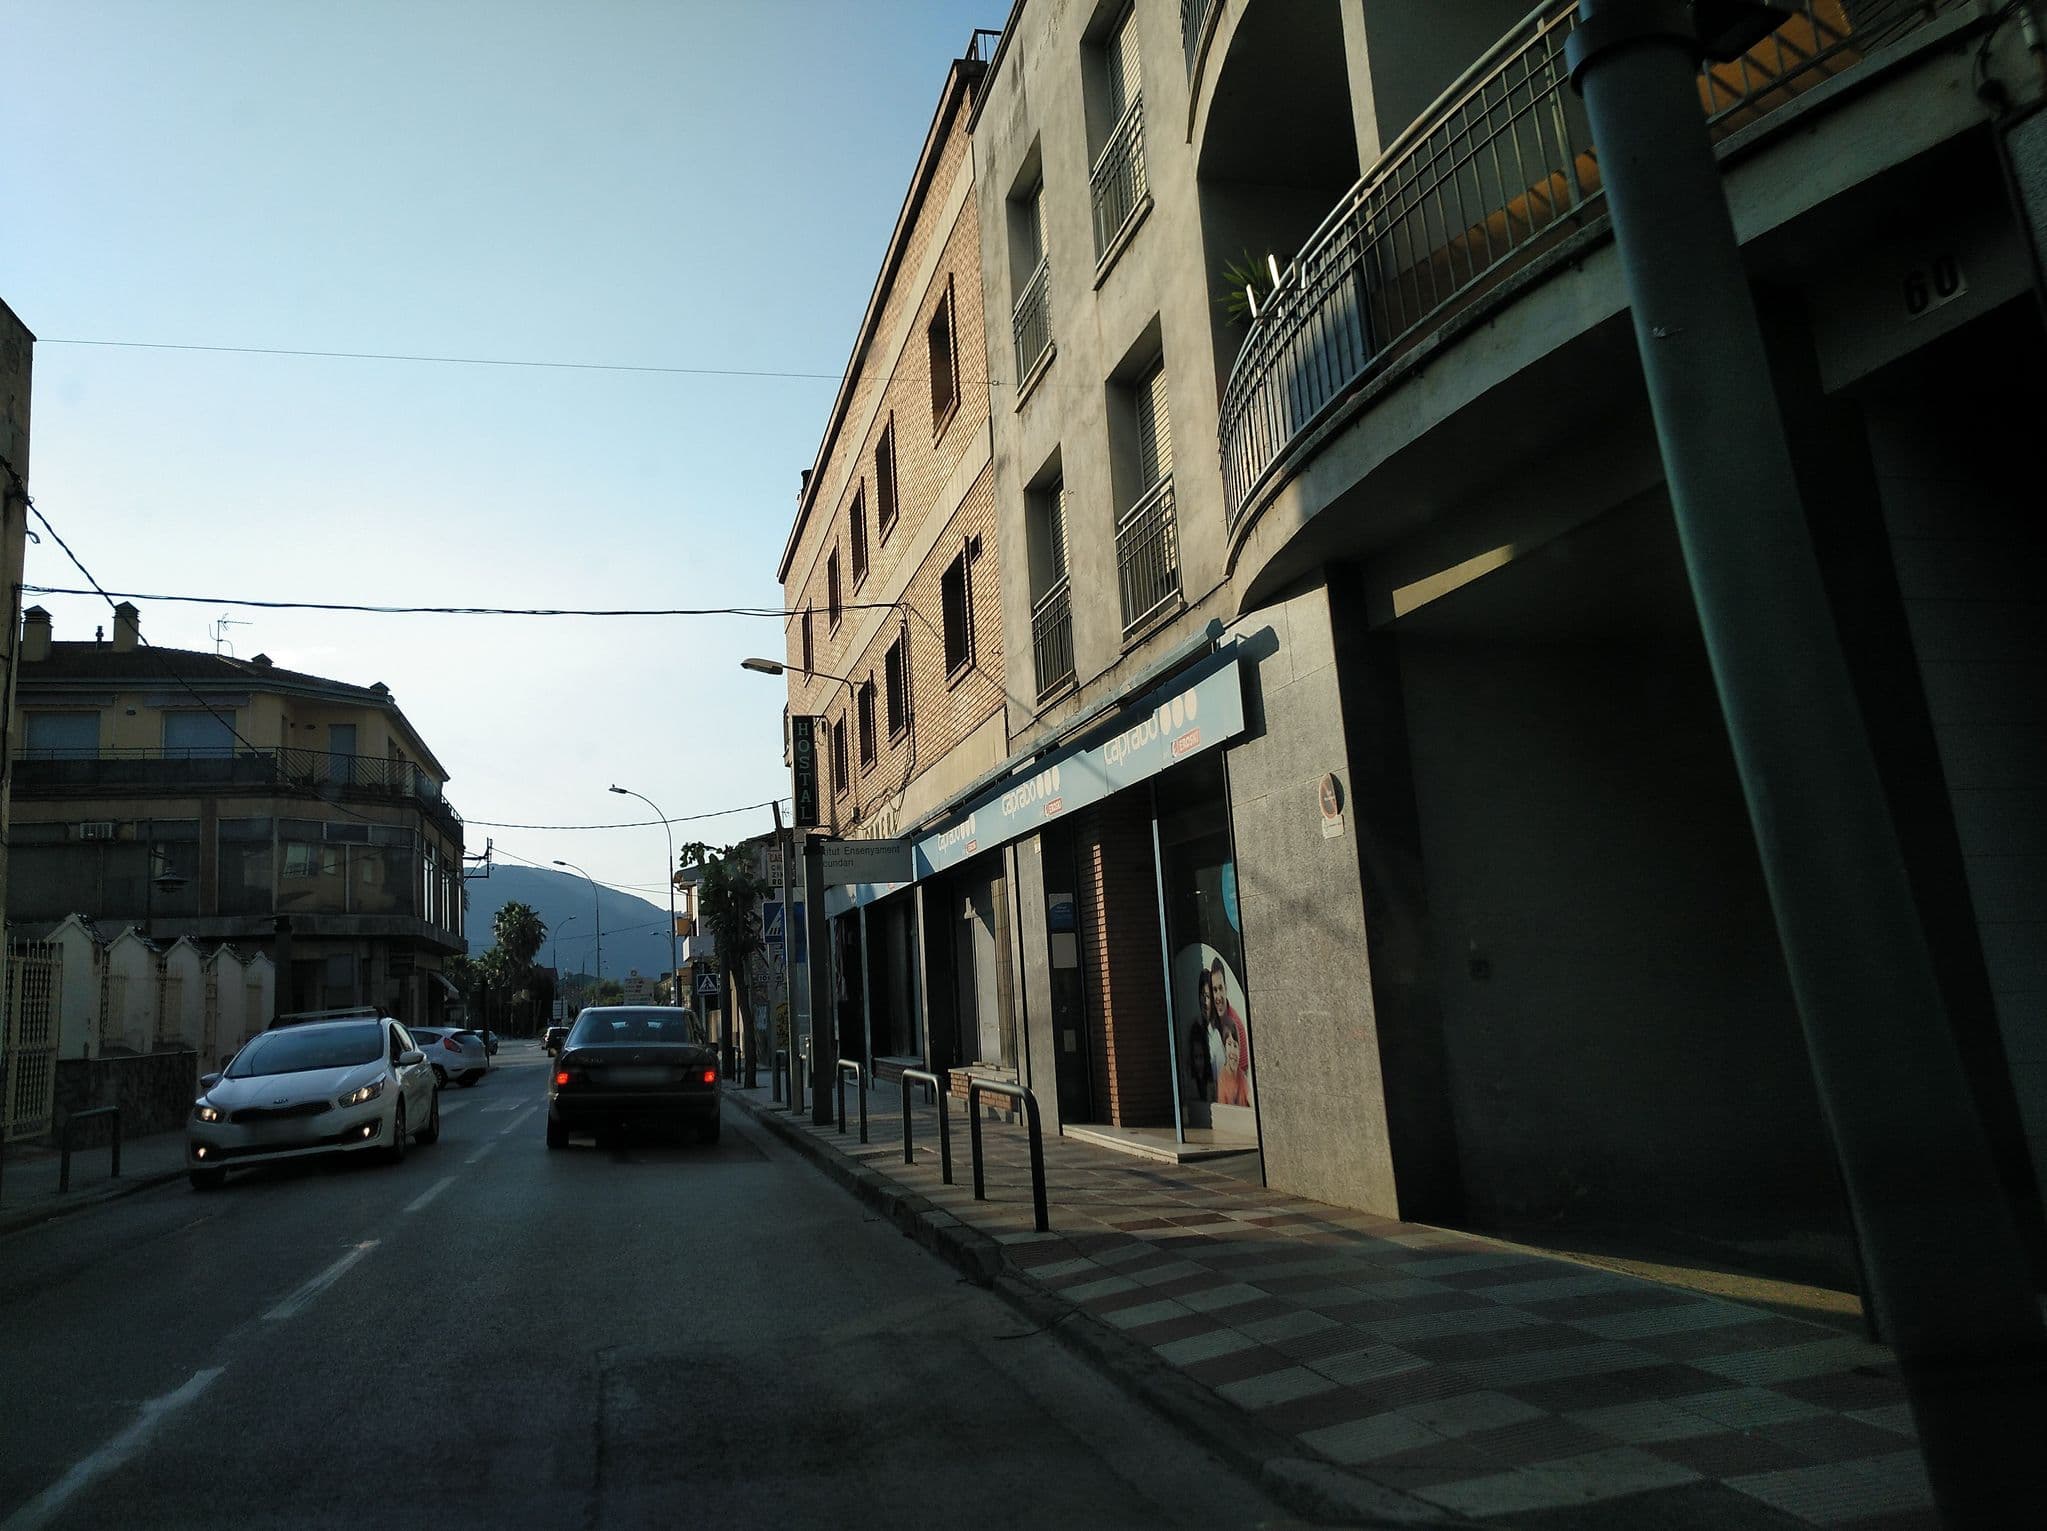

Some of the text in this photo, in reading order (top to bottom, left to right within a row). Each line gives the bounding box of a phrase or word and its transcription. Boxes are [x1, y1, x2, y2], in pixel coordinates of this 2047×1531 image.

[1903, 256, 1959, 315] 60
[797, 722, 813, 820] HOSTAL
[823, 859, 854, 868] cundari
[844, 846, 900, 857] Ensenyament
